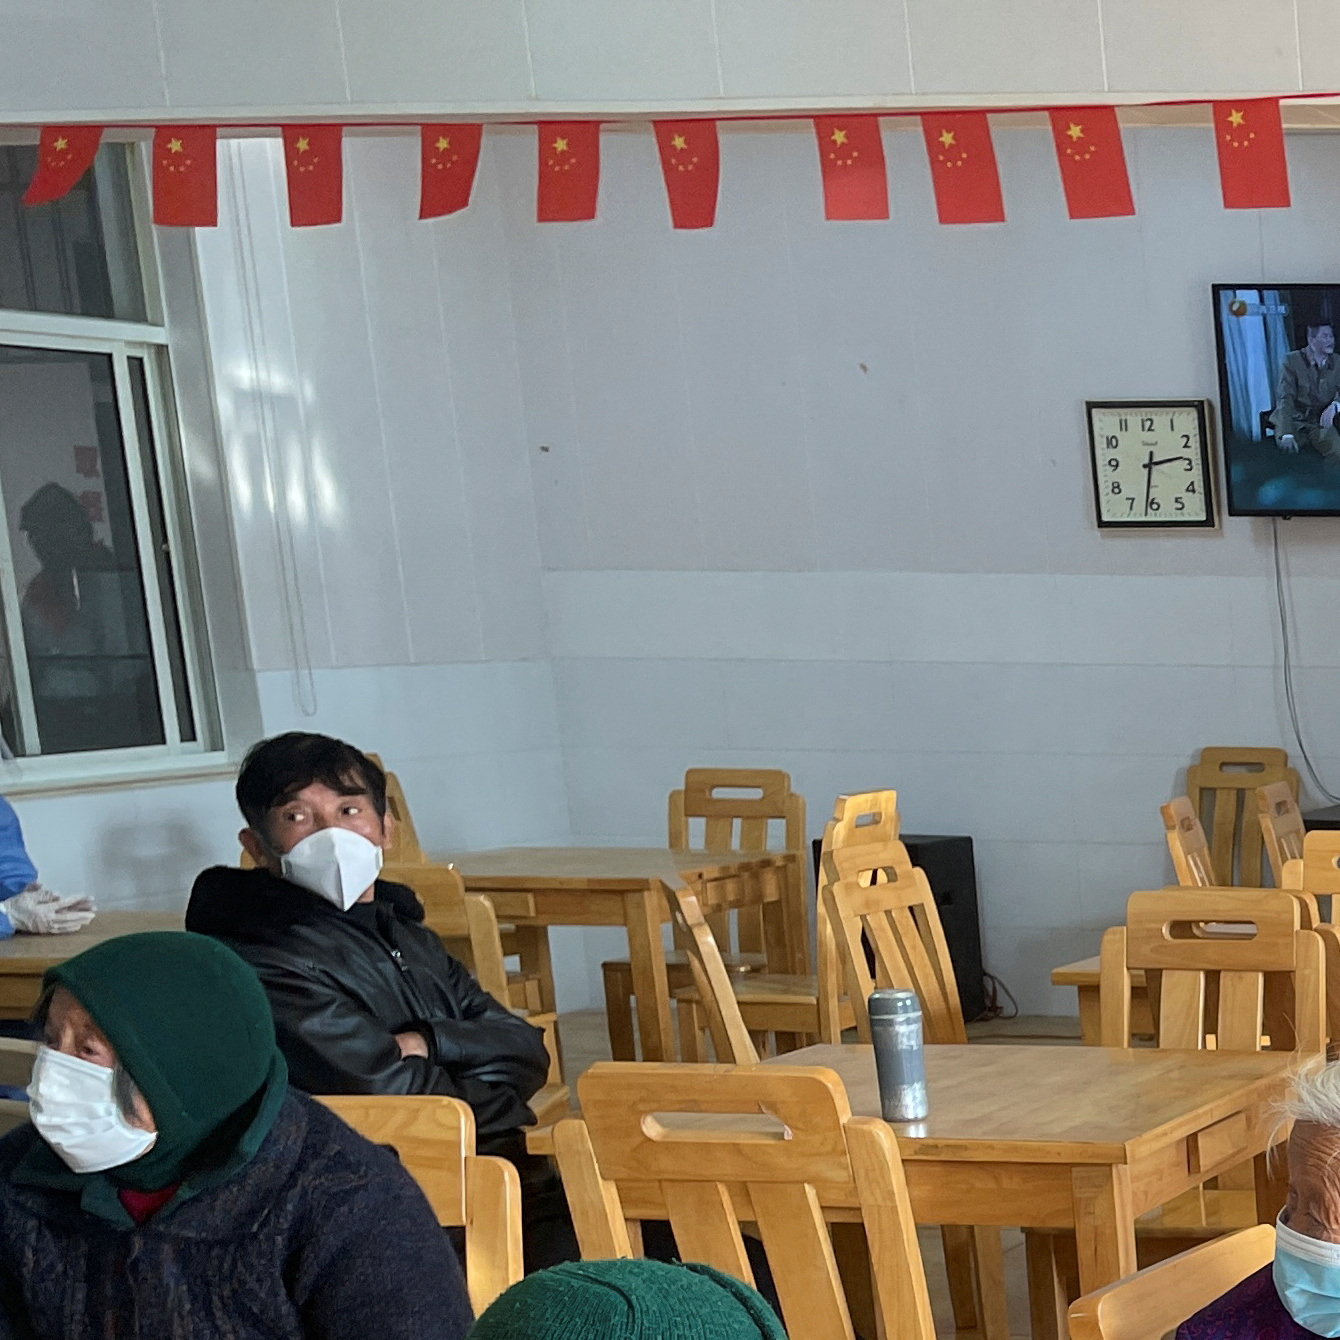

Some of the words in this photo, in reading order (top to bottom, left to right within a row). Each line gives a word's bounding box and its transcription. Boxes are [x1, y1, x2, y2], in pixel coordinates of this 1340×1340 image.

[1119, 418, 1129, 432] 11
[1140, 417, 1155, 432] 12
[1106, 434, 1119, 449] 10
[1180, 434, 1192, 449] 2
[1107, 457, 1119, 472] 9
[1183, 457, 1194, 472] 3
[1111, 481, 1122, 495] 8
[1185, 480, 1196, 495] 4
[1125, 497, 1136, 512] 7
[1149, 497, 1161, 511] 6
[1174, 497, 1185, 511] 5
